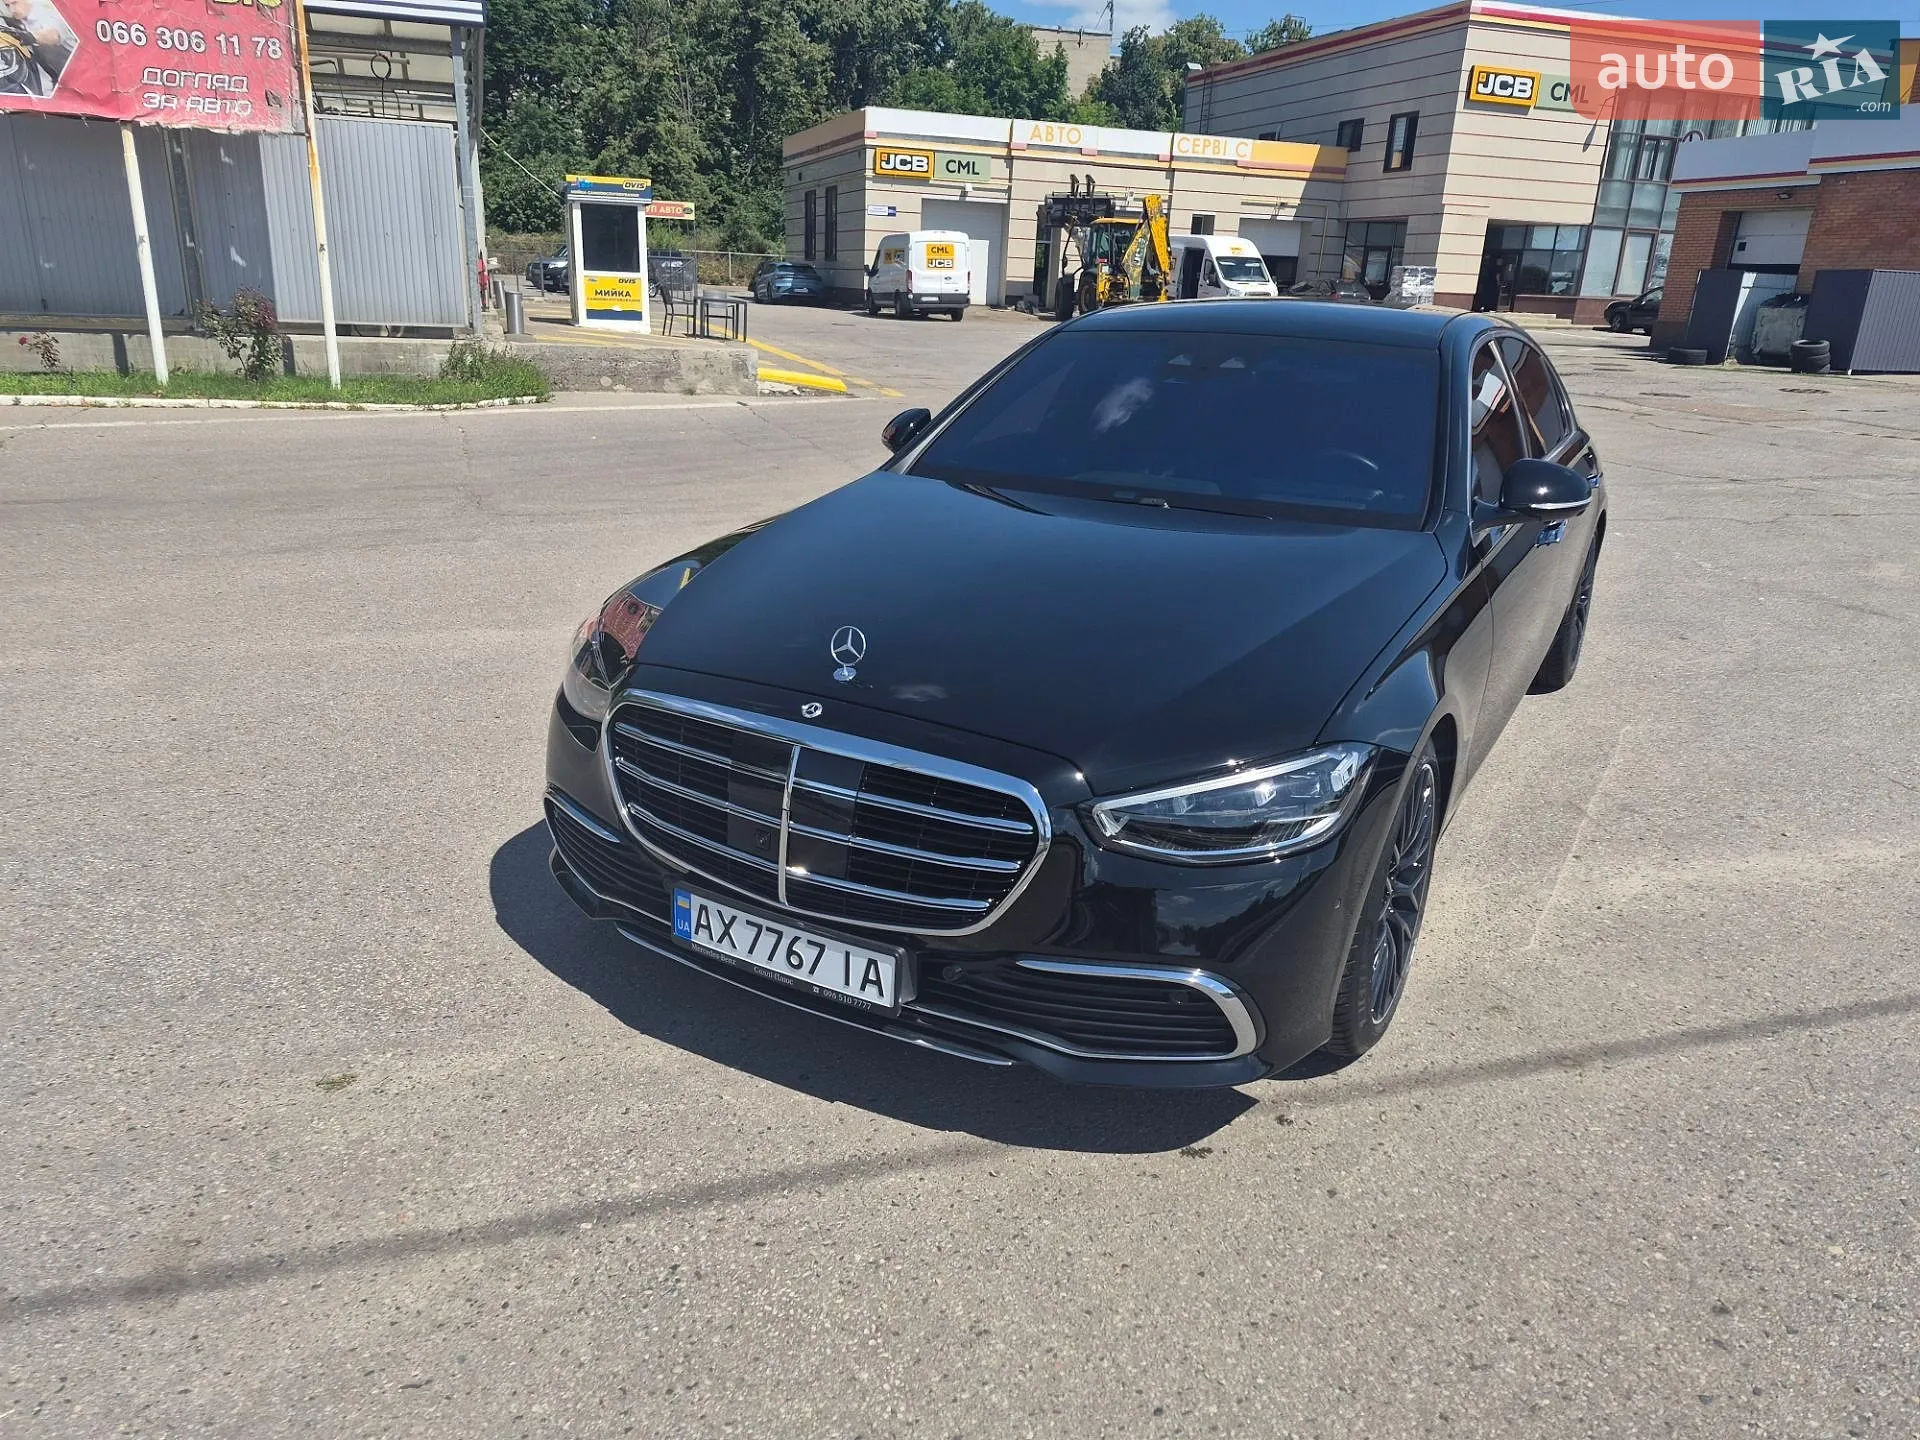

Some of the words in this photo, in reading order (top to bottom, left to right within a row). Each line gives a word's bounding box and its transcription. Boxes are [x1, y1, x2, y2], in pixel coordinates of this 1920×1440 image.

[96, 20, 147, 46] 066
[155, 26, 206, 53] 306
[215, 33, 240, 56] 11
[251, 36, 282, 60] 78
[141, 67, 248, 93] ДОГЛЯД
[1477, 72, 1533, 98] JCB
[1550, 81, 1589, 104] CML
[142, 92, 177, 110] ЗА
[185, 96, 253, 118] АВТО
[1030, 124, 1082, 145] АВТО
[880, 152, 929, 172] JCB
[945, 159, 980, 176] CML
[930, 246, 950, 254] CML
[928, 259, 953, 268] JCB
[594, 288, 632, 298] МИЙКА
[677, 919, 690, 933] UA
[694, 903, 738, 950] AX
[745, 919, 827, 976] 7767
[844, 950, 885, 998] IA
